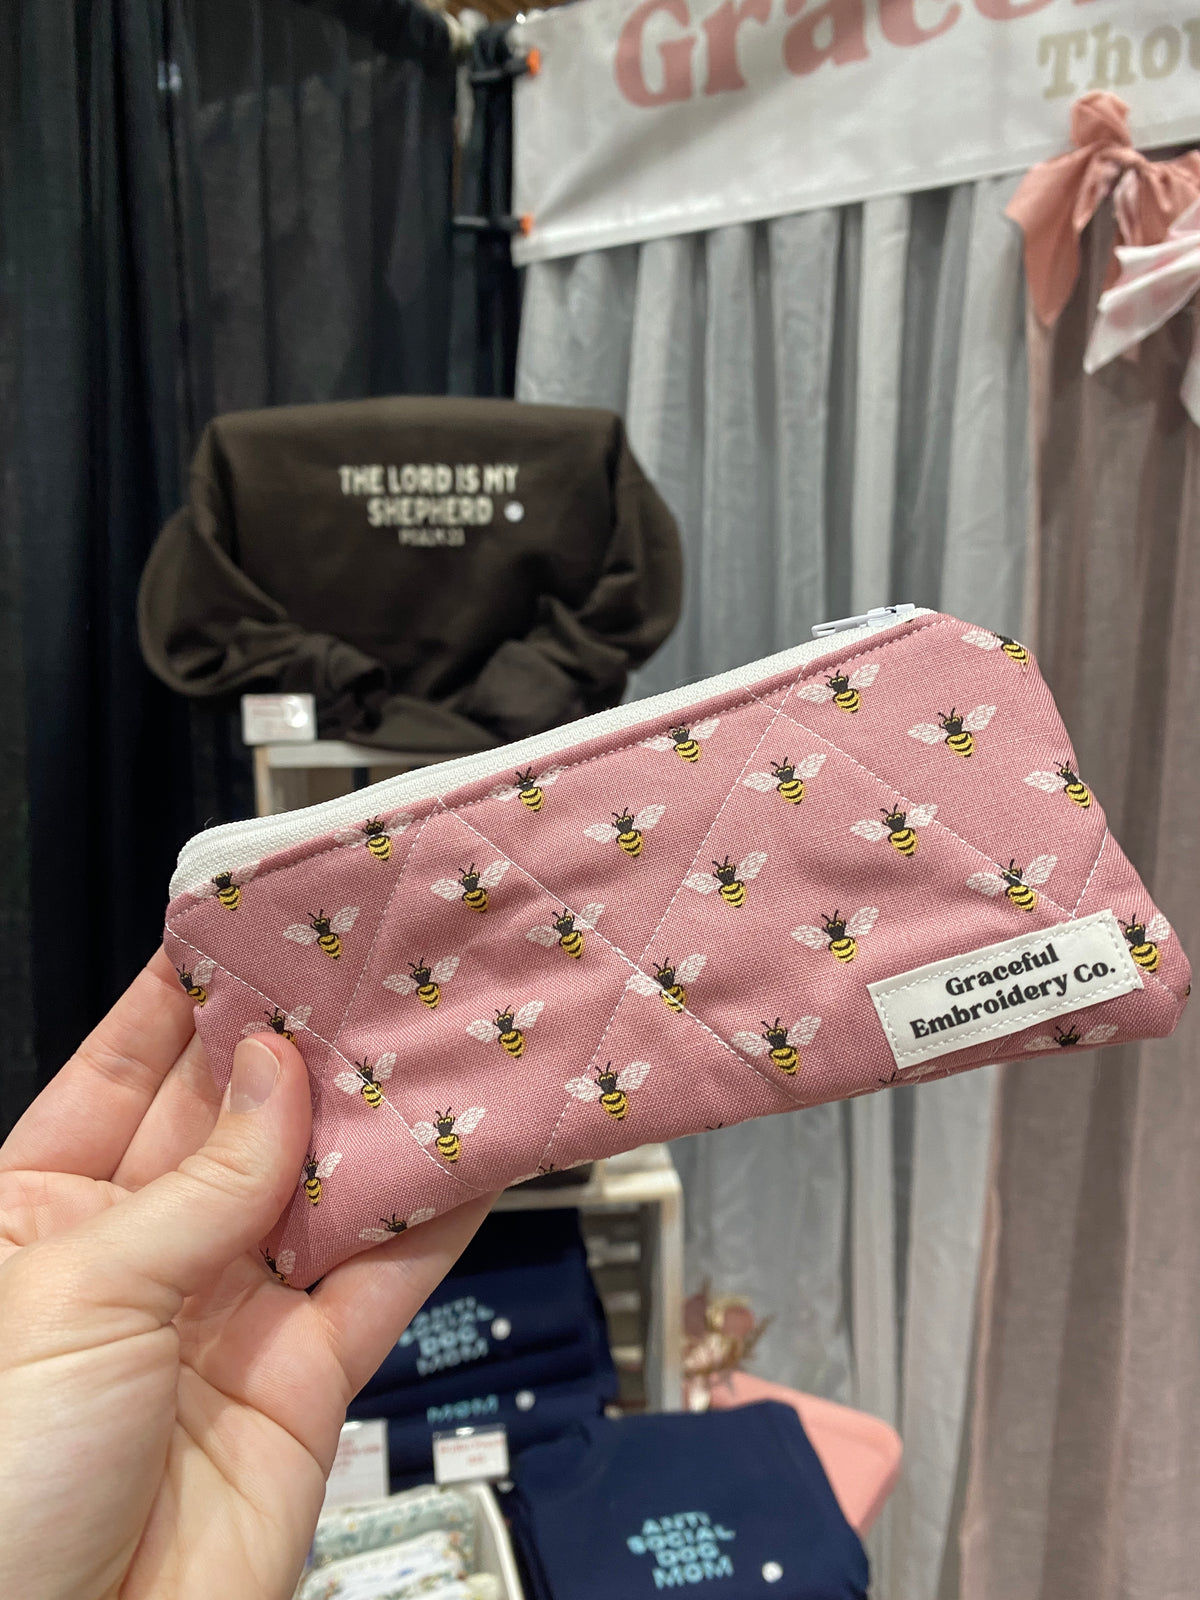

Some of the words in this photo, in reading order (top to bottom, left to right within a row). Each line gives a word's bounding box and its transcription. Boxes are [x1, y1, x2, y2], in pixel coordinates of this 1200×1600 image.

[339, 465, 385, 495] THE
[387, 464, 453, 495] LORD
[455, 464, 481, 494] IS
[483, 464, 518, 494] MY
[367, 497, 493, 527] SHEPHERD
[945, 943, 1059, 996] Graceful
[909, 972, 1068, 1039] Embroidery
[1073, 962, 1116, 984] Co.
[642, 1511, 710, 1536] ANTI
[626, 1524, 736, 1555] SOCIAL
[655, 1541, 719, 1568] DOG
[652, 1555, 734, 1590] MOM
